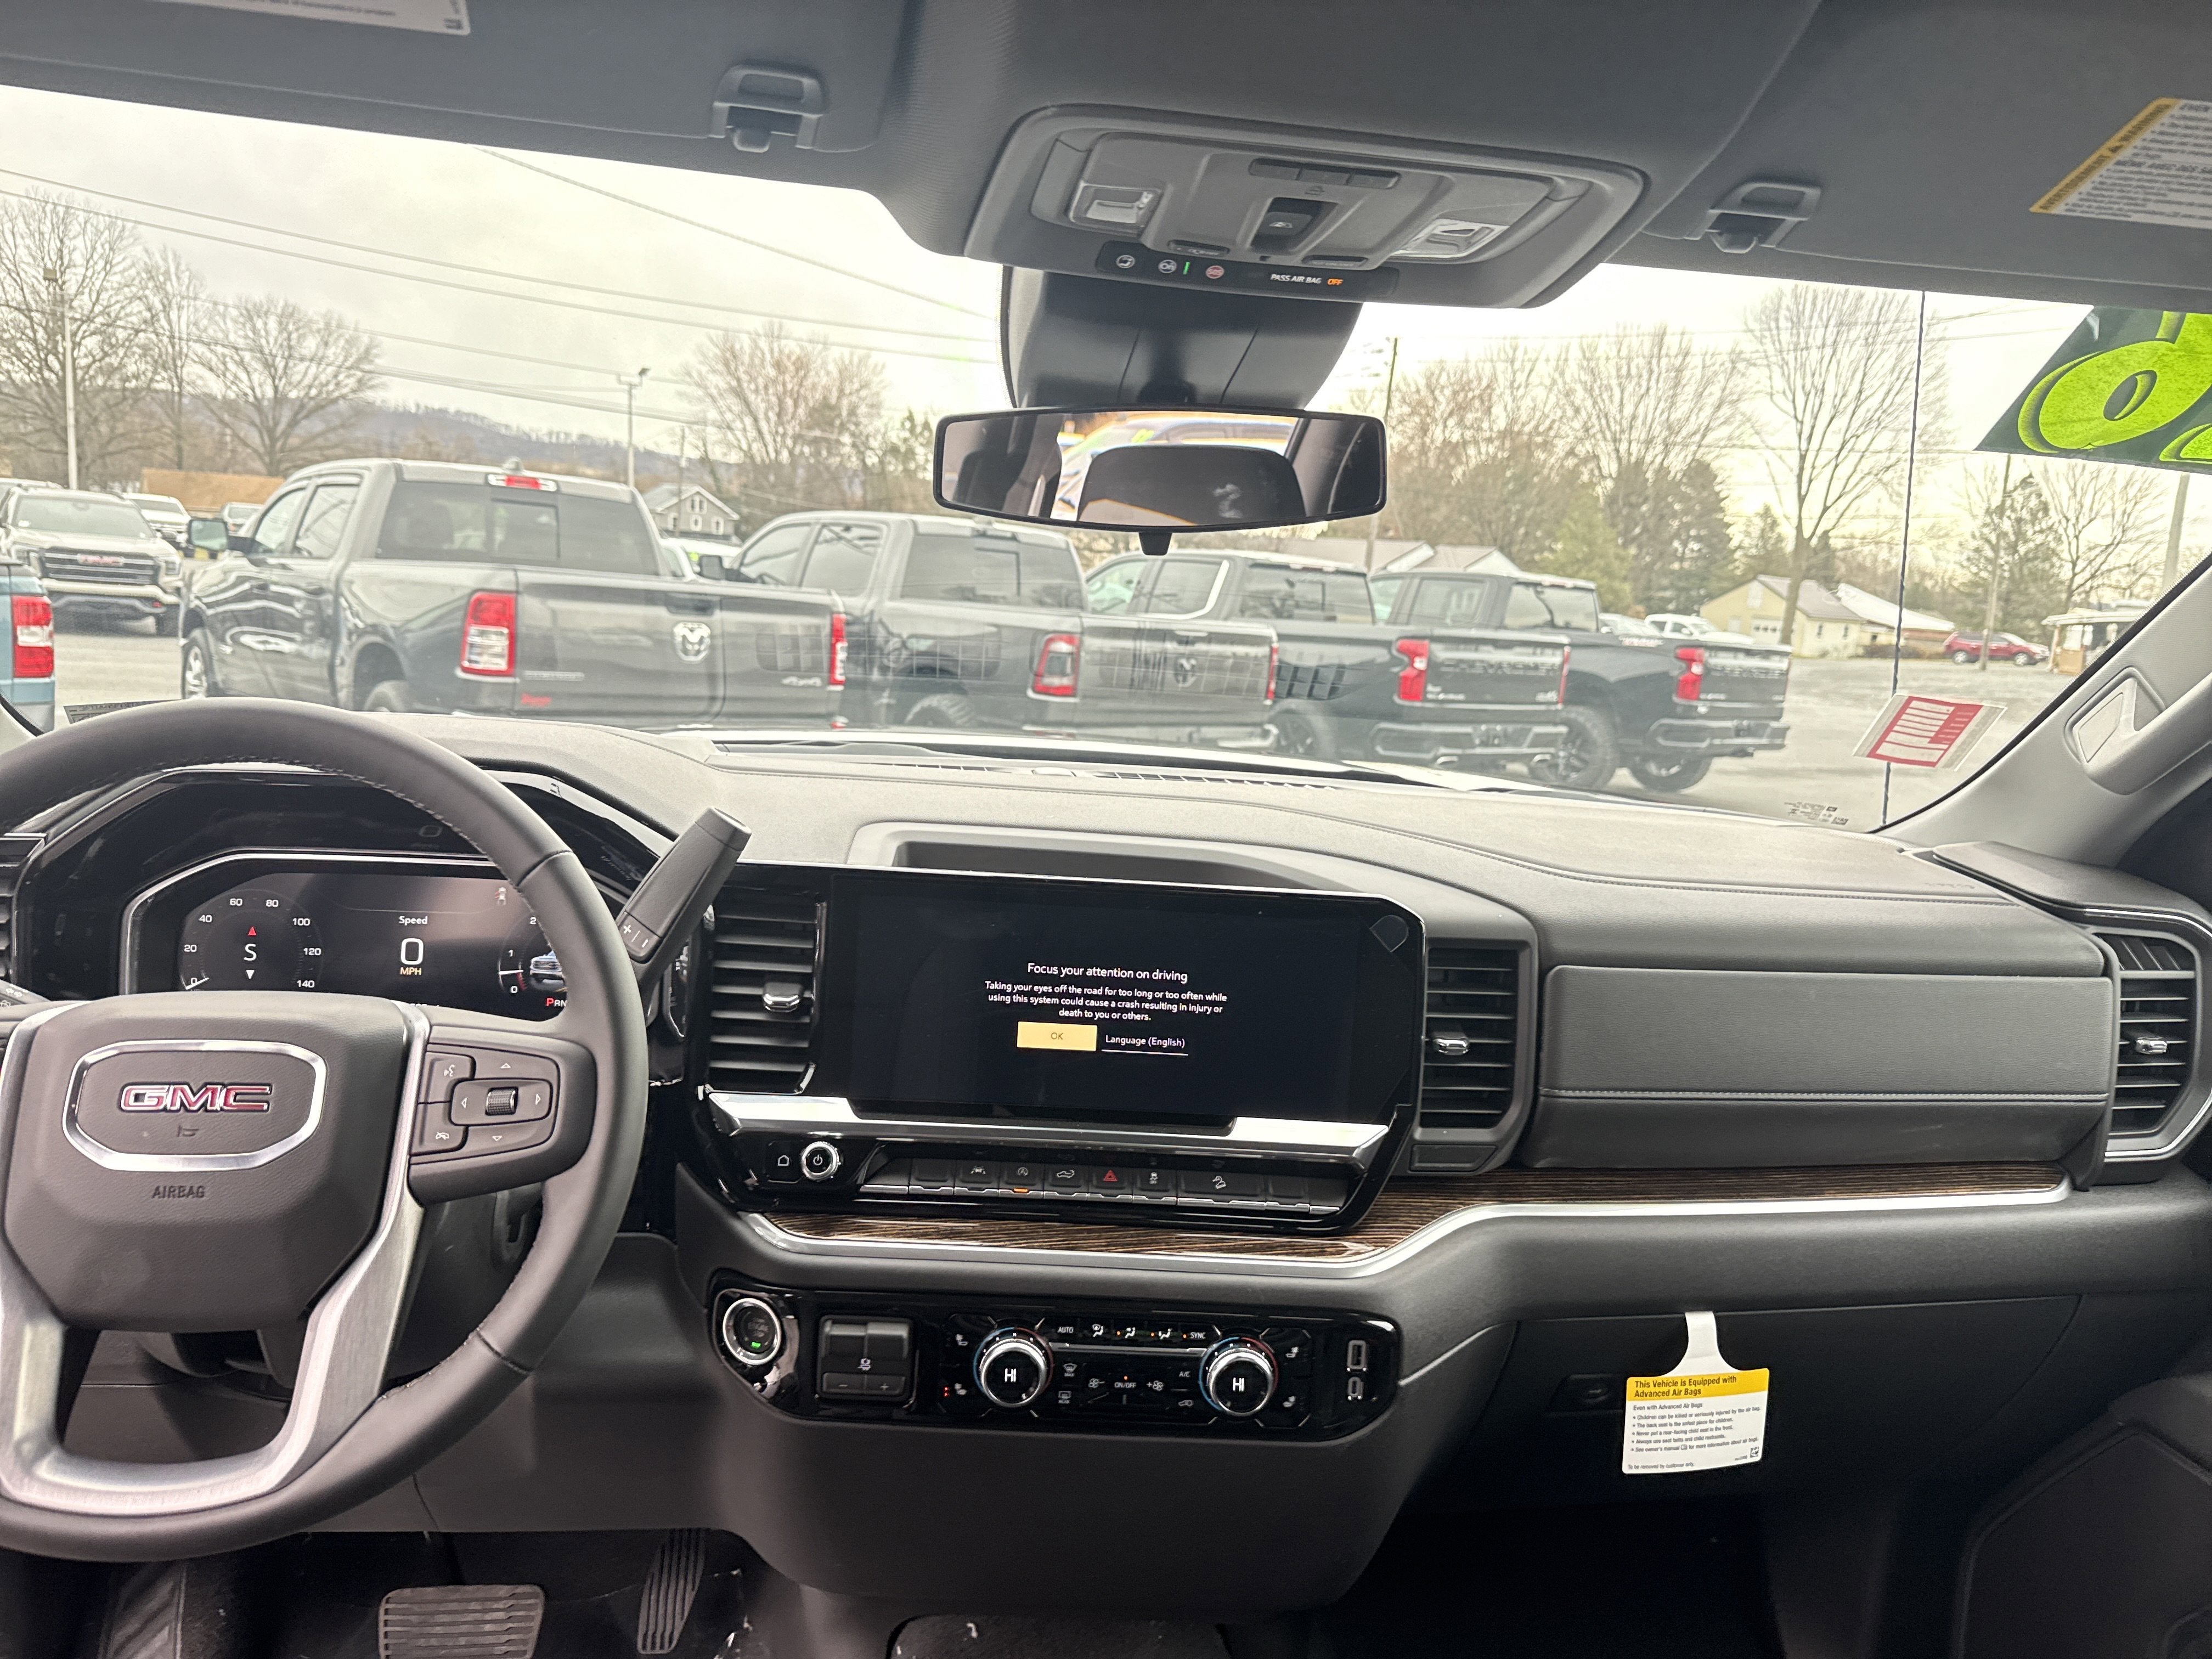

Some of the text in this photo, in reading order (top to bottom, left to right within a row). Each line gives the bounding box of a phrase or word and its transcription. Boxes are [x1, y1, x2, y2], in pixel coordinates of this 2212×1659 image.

[266, 899, 279, 907] 80
[199, 915, 212, 923] 40
[292, 918, 311, 926] 100
[399, 916, 428, 926] Speed
[184, 944, 197, 952] 20
[244, 943, 257, 961] S
[303, 947, 321, 956] 120
[400, 938, 424, 965] 0
[399, 967, 422, 975] MPH
[1028, 962, 1058, 974] Focus
[1060, 967, 1085, 978] your
[1086, 967, 1134, 978] attention
[1152, 969, 1188, 984] driving
[190, 977, 198, 985] 0
[297, 980, 315, 988] 140
[985, 980, 1012, 992] Taking
[1013, 984, 1032, 992] your
[1033, 985, 1053, 994] eyes
[1054, 984, 1067, 993] off
[1068, 985, 1082, 994] the
[1084, 986, 1103, 995] road
[1104, 987, 1118, 996] for
[1118, 988, 1132, 996] too
[1135, 989, 1153, 1000] long
[1165, 991, 1180, 999] too
[1181, 991, 1204, 1000] often
[1205, 992, 1227, 1002] while
[988, 994, 1011, 1004] using
[1012, 994, 1028, 1003] this
[1030, 996, 1059, 1006] system
[1060, 997, 1084, 1006] could
[1085, 999, 1109, 1007] cause
[1117, 1000, 1140, 1009] crash
[1142, 1001, 1177, 1013] resulting
[1179, 1003, 1187, 1011] in
[1189, 1003, 1212, 1014] injury
[1059, 1008, 1082, 1017] death
[1122, 1012, 1152, 1021] others.
[1051, 1032, 1064, 1040] OK
[1105, 1035, 1186, 1048] Language (English)
[120, 1084, 273, 1112] GMC
[151, 1185, 205, 1199] AIRBAG
[1004, 1368, 1017, 1383] HI
[1232, 1377, 1245, 1392] HI
[1689, 1376, 1720, 1387] Equipped
[1634, 1389, 1670, 1398] Advanced
[1684, 1388, 1701, 1396] Bags
